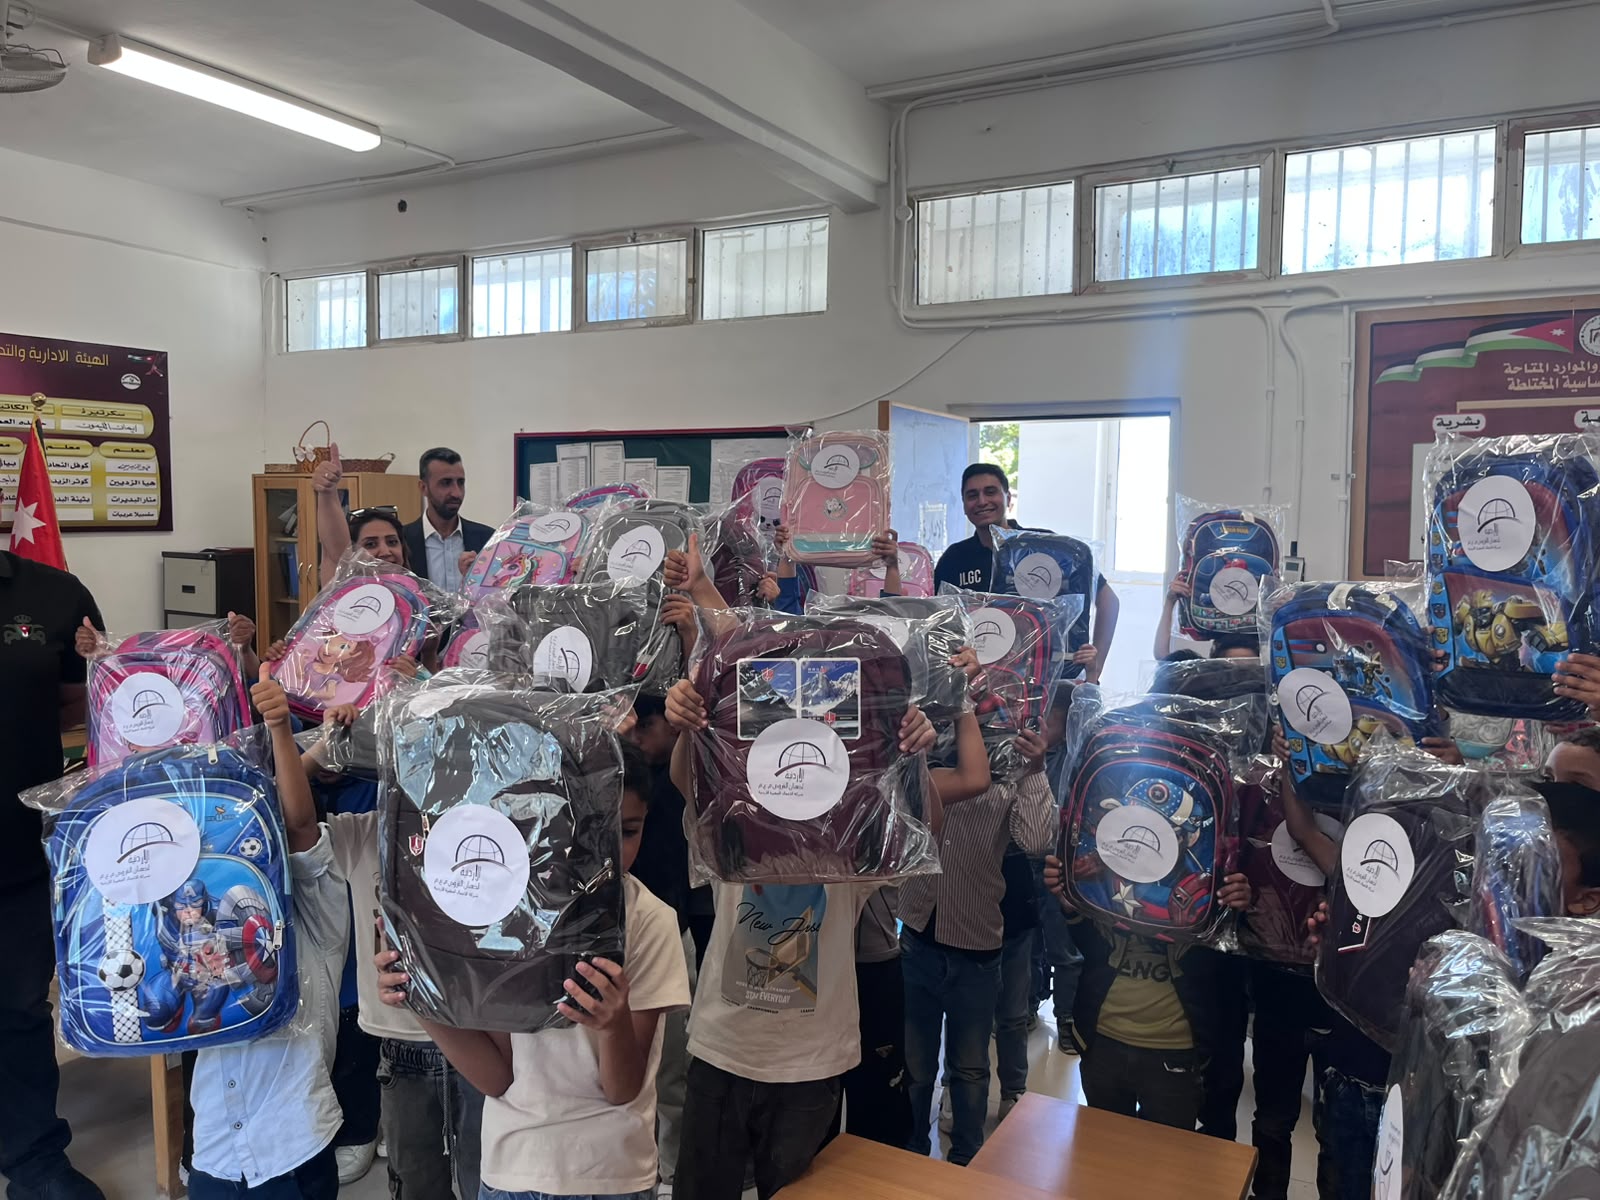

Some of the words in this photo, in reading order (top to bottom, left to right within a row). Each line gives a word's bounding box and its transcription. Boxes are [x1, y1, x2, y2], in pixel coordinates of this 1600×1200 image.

[75, 351, 109, 367] الهيئة
[1503, 362, 1549, 374] المتاحة
[1552, 360, 1599, 374] والموارد
[1507, 377, 1559, 391] المختلطة
[1436, 416, 1481, 430] بشرية
[959, 569, 982, 586] JLGC
[736, 902, 774, 932] New
[759, 992, 791, 1004] EVERYDAY
